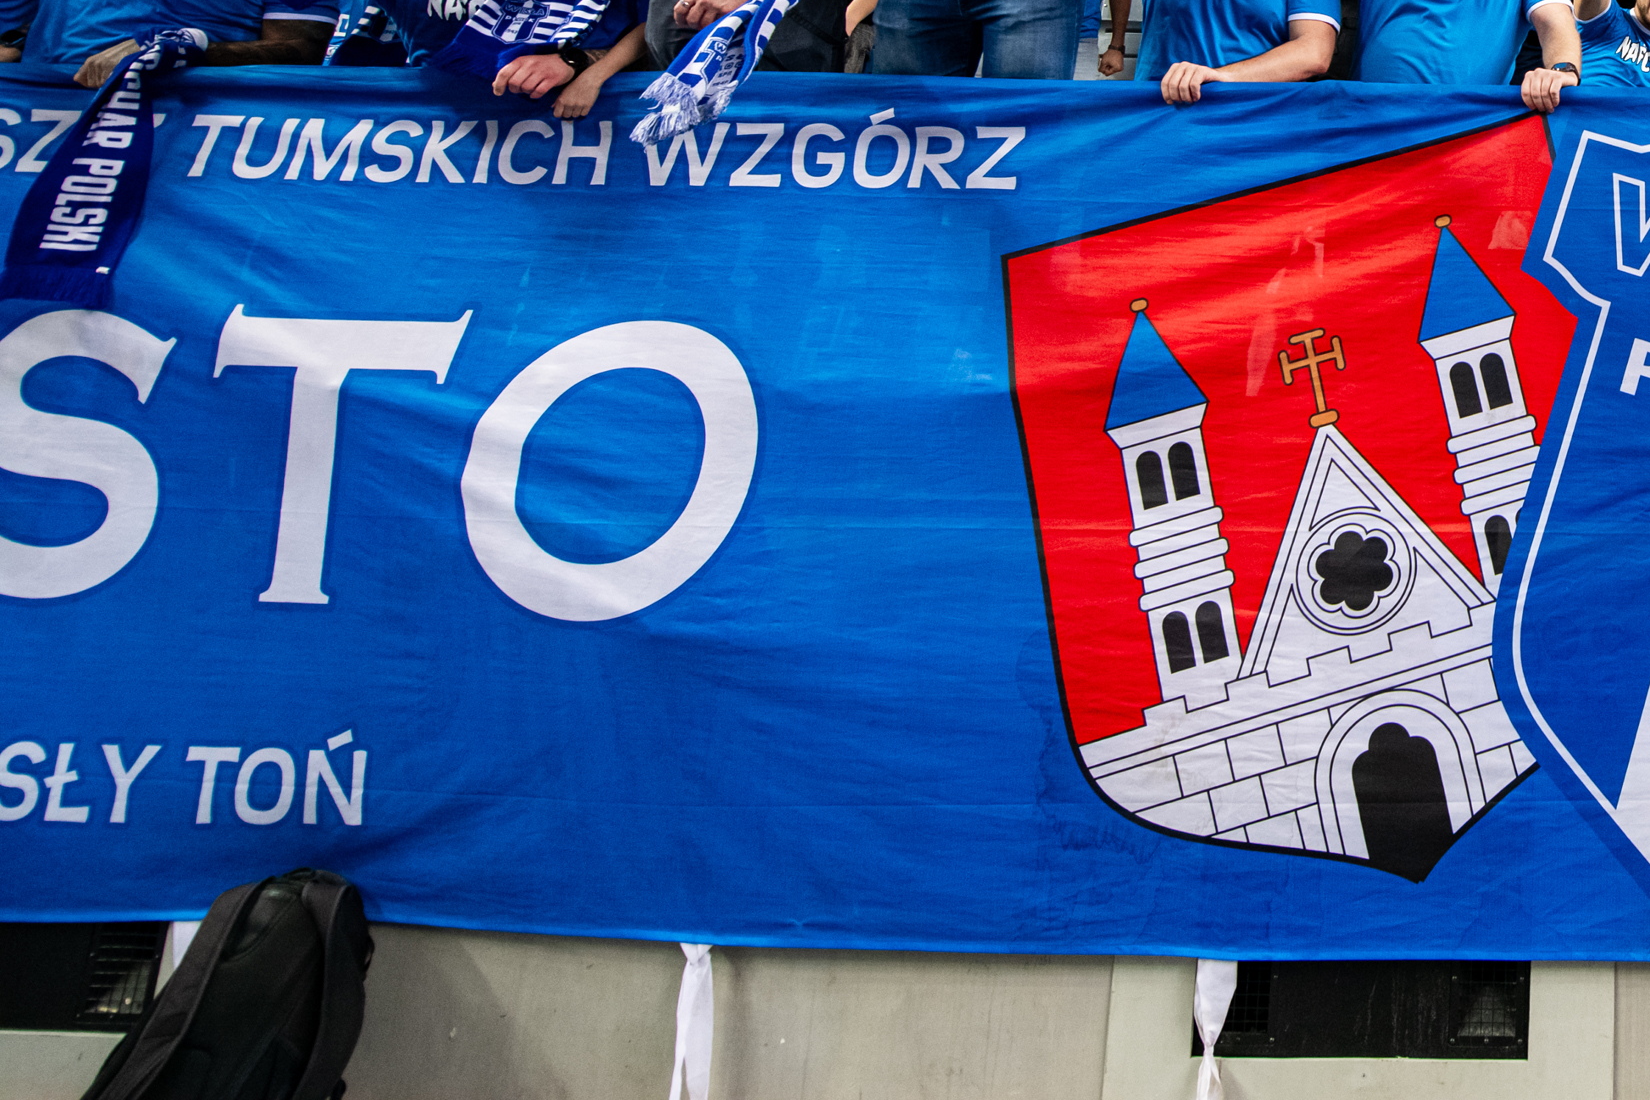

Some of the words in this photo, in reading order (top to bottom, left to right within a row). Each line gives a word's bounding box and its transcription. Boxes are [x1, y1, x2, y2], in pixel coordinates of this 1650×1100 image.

[187, 114, 613, 186] TUMSKICH
[643, 107, 1027, 191] WZGÓRZ
[39, 157, 125, 252] POLSKI
[186, 729, 368, 826] TOŃ
